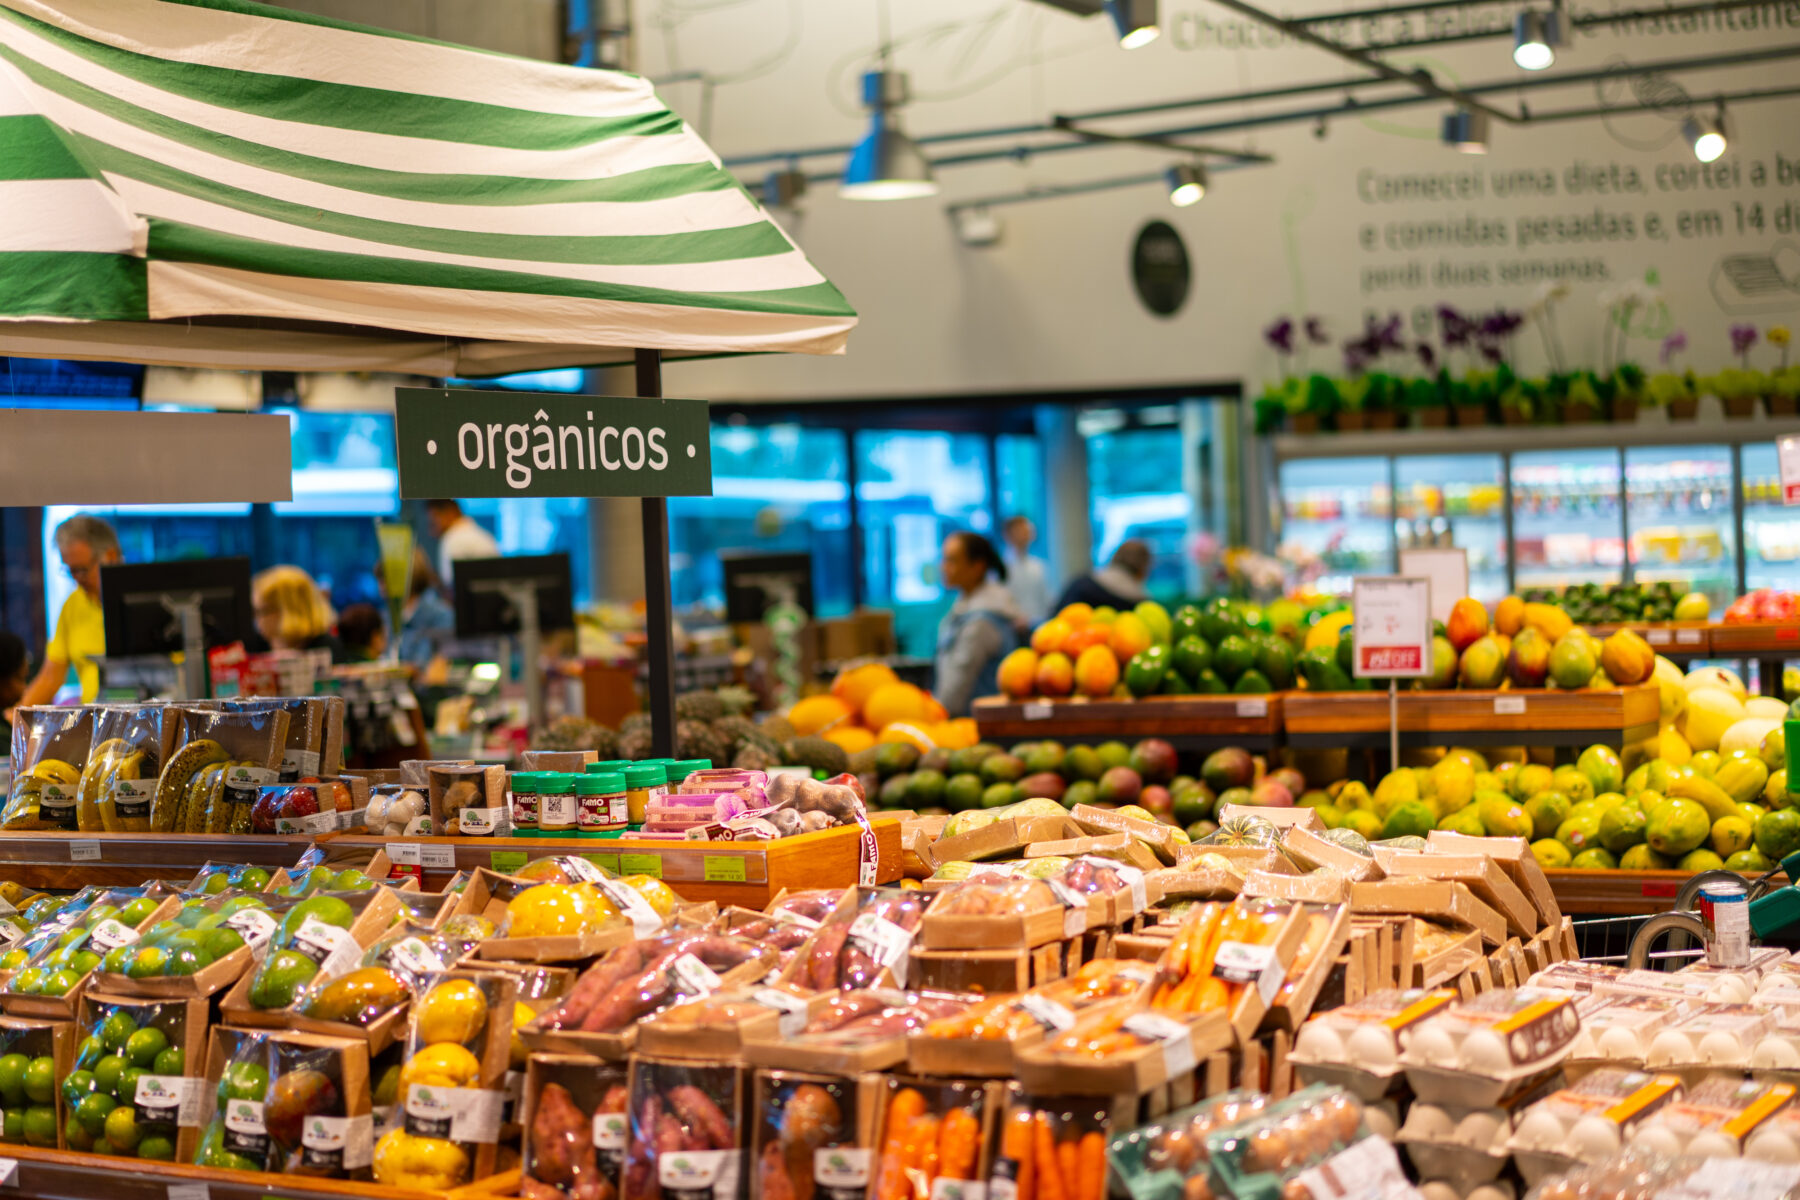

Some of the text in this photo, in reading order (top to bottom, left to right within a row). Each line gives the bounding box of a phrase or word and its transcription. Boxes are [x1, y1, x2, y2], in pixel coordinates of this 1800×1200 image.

[1170, 9, 1348, 51] Chocote
[1357, 164, 1484, 203] Comecei
[1491, 168, 1556, 197] uma
[1655, 154, 1742, 191] cortei
[1749, 160, 1767, 188] a
[1359, 222, 1379, 251] e
[1384, 213, 1510, 251] comidas
[1516, 205, 1638, 252] pesadas
[1676, 209, 1723, 239] em
[1733, 201, 1766, 236] 14
[458, 408, 669, 489] orgânicos
[517, 796, 538, 805] FAMO
[582, 798, 604, 807] FAMO
[867, 834, 877, 872] FAMO
